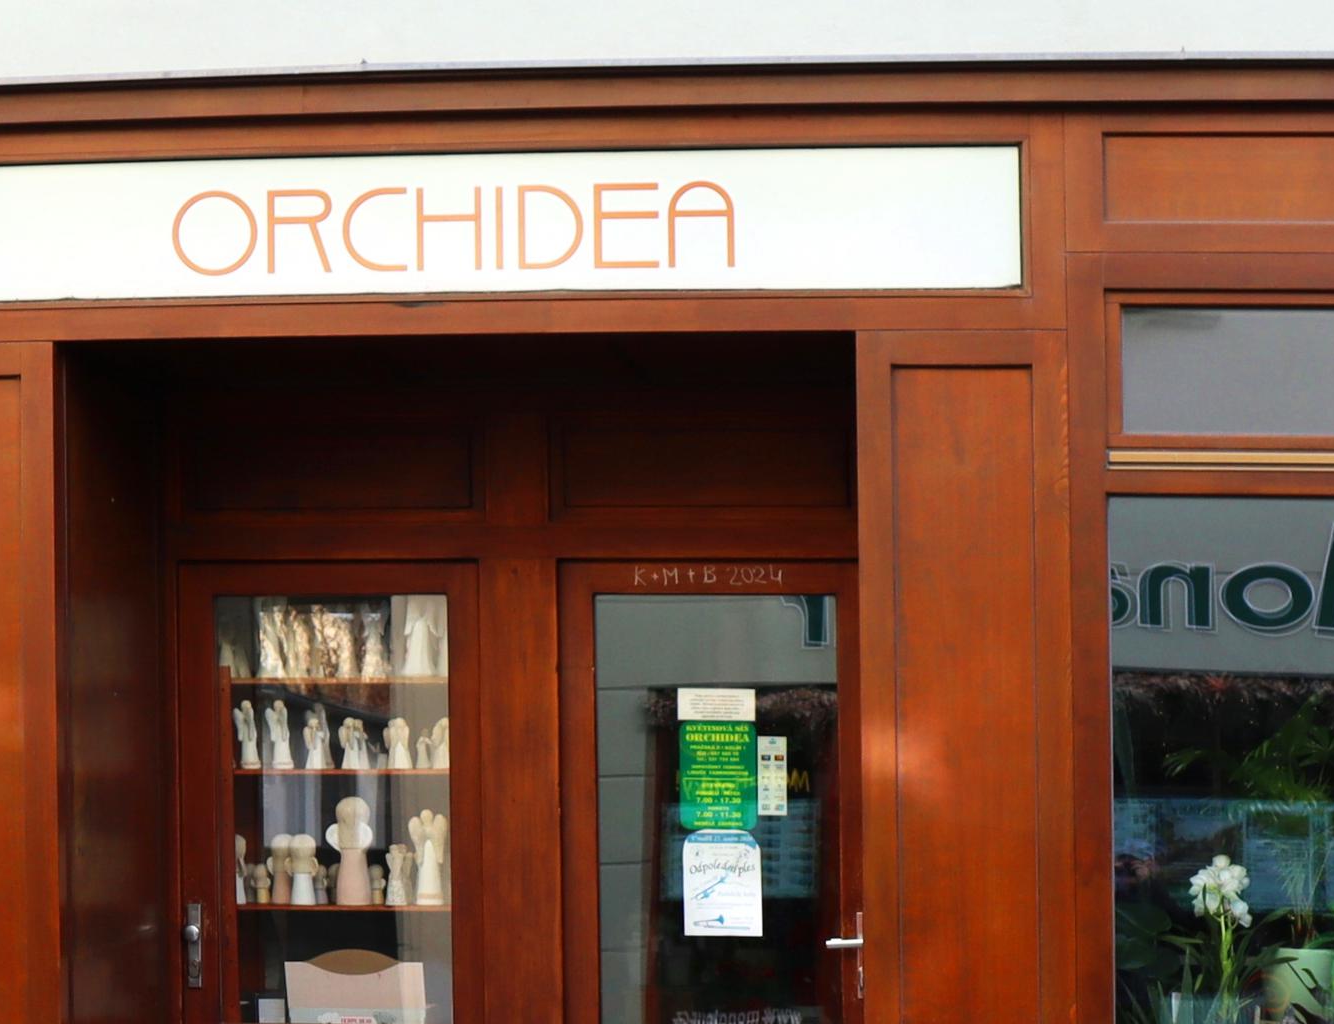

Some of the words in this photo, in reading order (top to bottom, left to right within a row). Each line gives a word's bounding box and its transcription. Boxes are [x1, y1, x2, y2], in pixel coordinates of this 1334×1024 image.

[171, 180, 736, 277] ORCHIDEA
[728, 563, 783, 588] 2024
[686, 732, 750, 743] ORCHIDEA
[738, 860, 756, 878] ples
